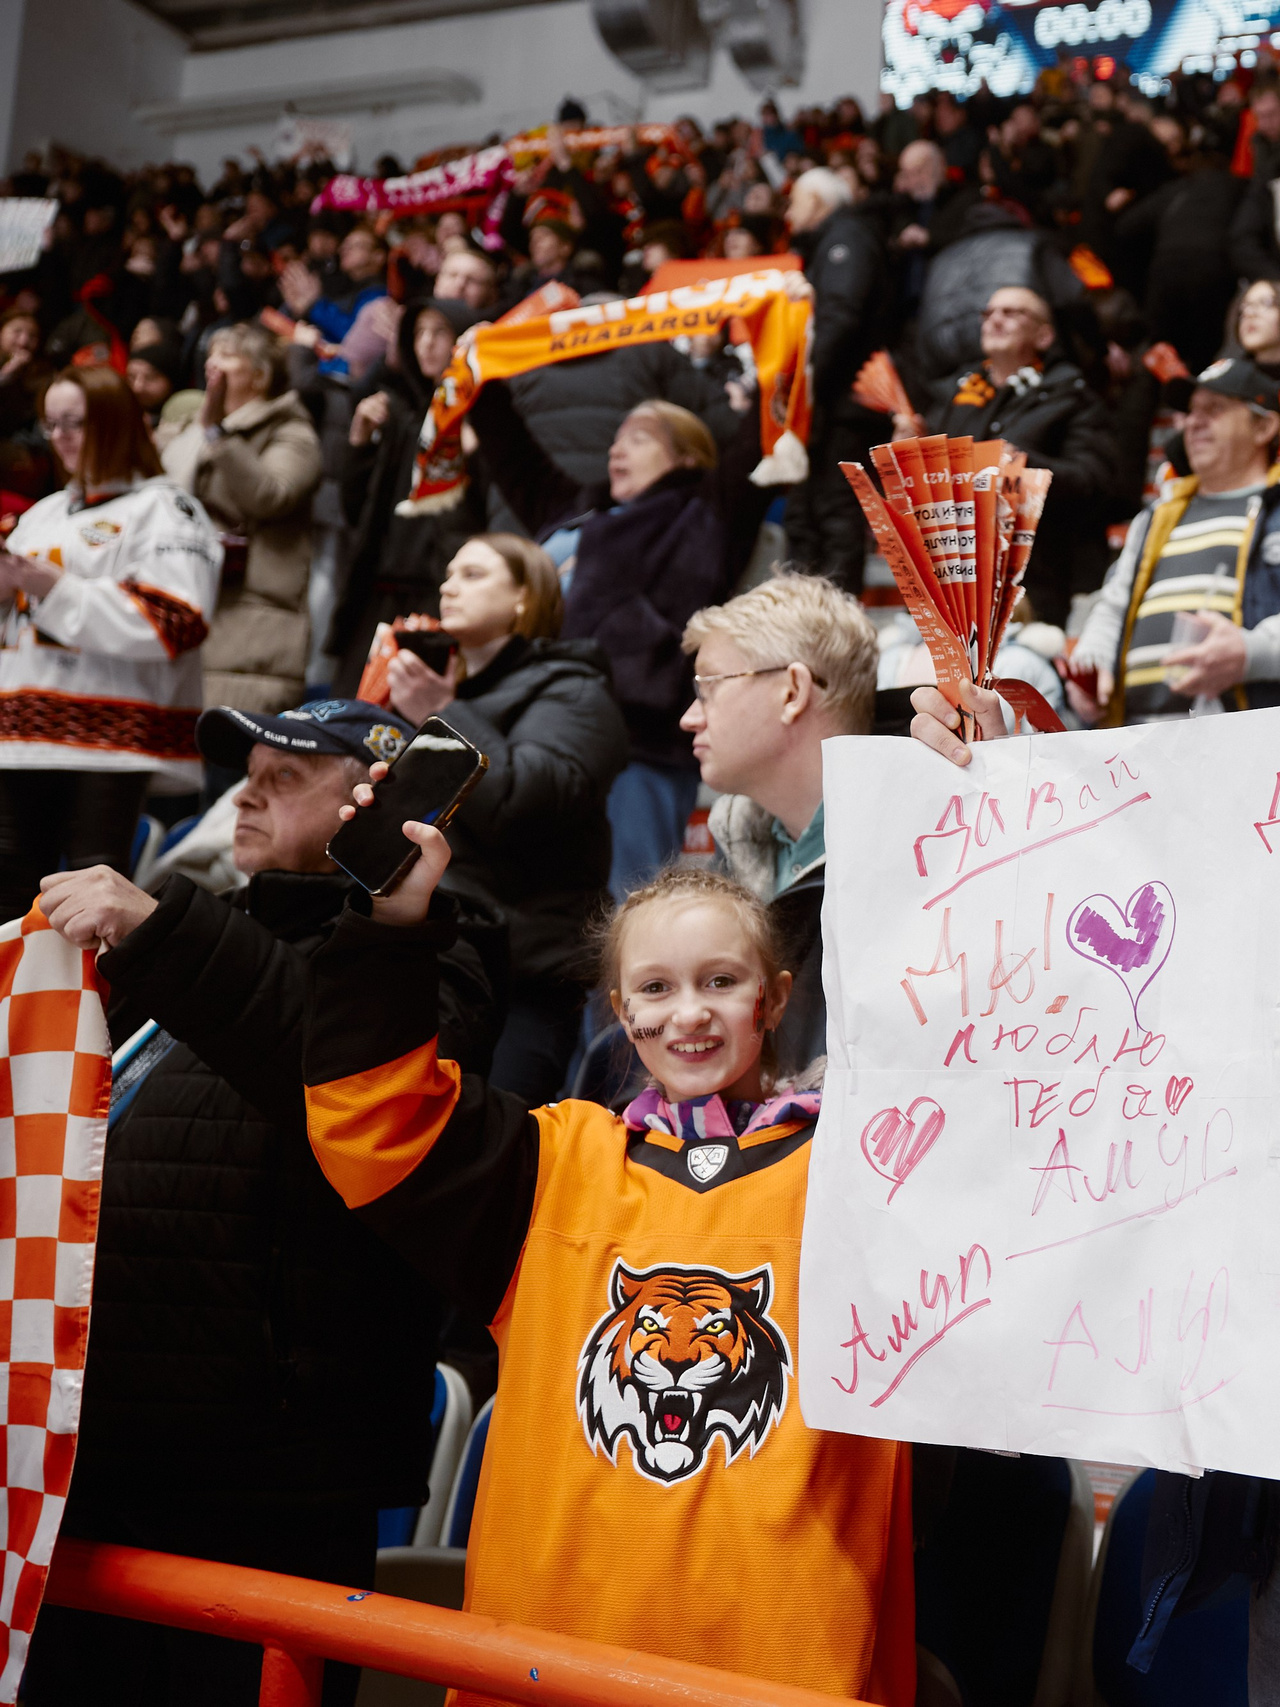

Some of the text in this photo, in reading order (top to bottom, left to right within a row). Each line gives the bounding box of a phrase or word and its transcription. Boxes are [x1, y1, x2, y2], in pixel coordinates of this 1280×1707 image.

[551, 302, 749, 352] KHABAROV
[264, 729, 289, 745] CLUB
[290, 737, 318, 750] AMUR
